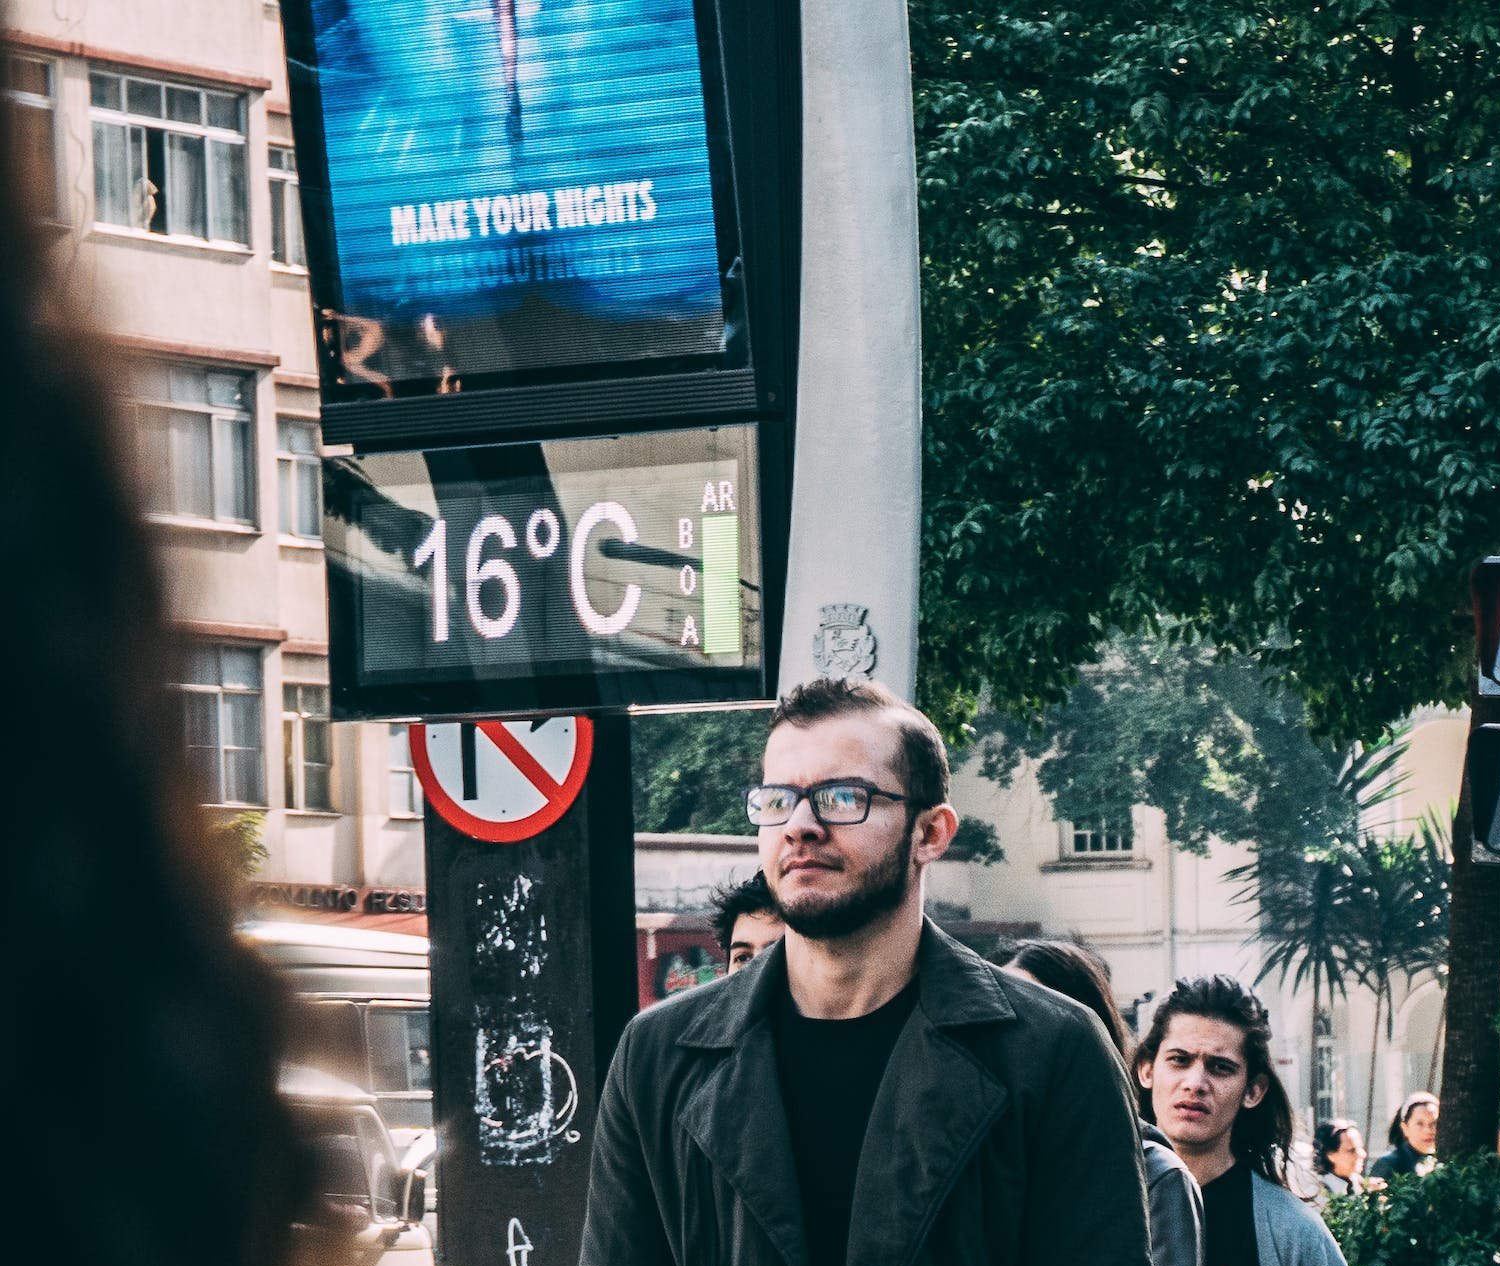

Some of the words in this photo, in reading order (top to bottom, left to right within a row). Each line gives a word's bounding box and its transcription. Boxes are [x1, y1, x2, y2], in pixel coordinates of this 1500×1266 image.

[390, 200, 470, 246] MAKE
[473, 191, 551, 236] YOUR
[554, 179, 657, 229] NIGHTS
[701, 480, 736, 513] AR
